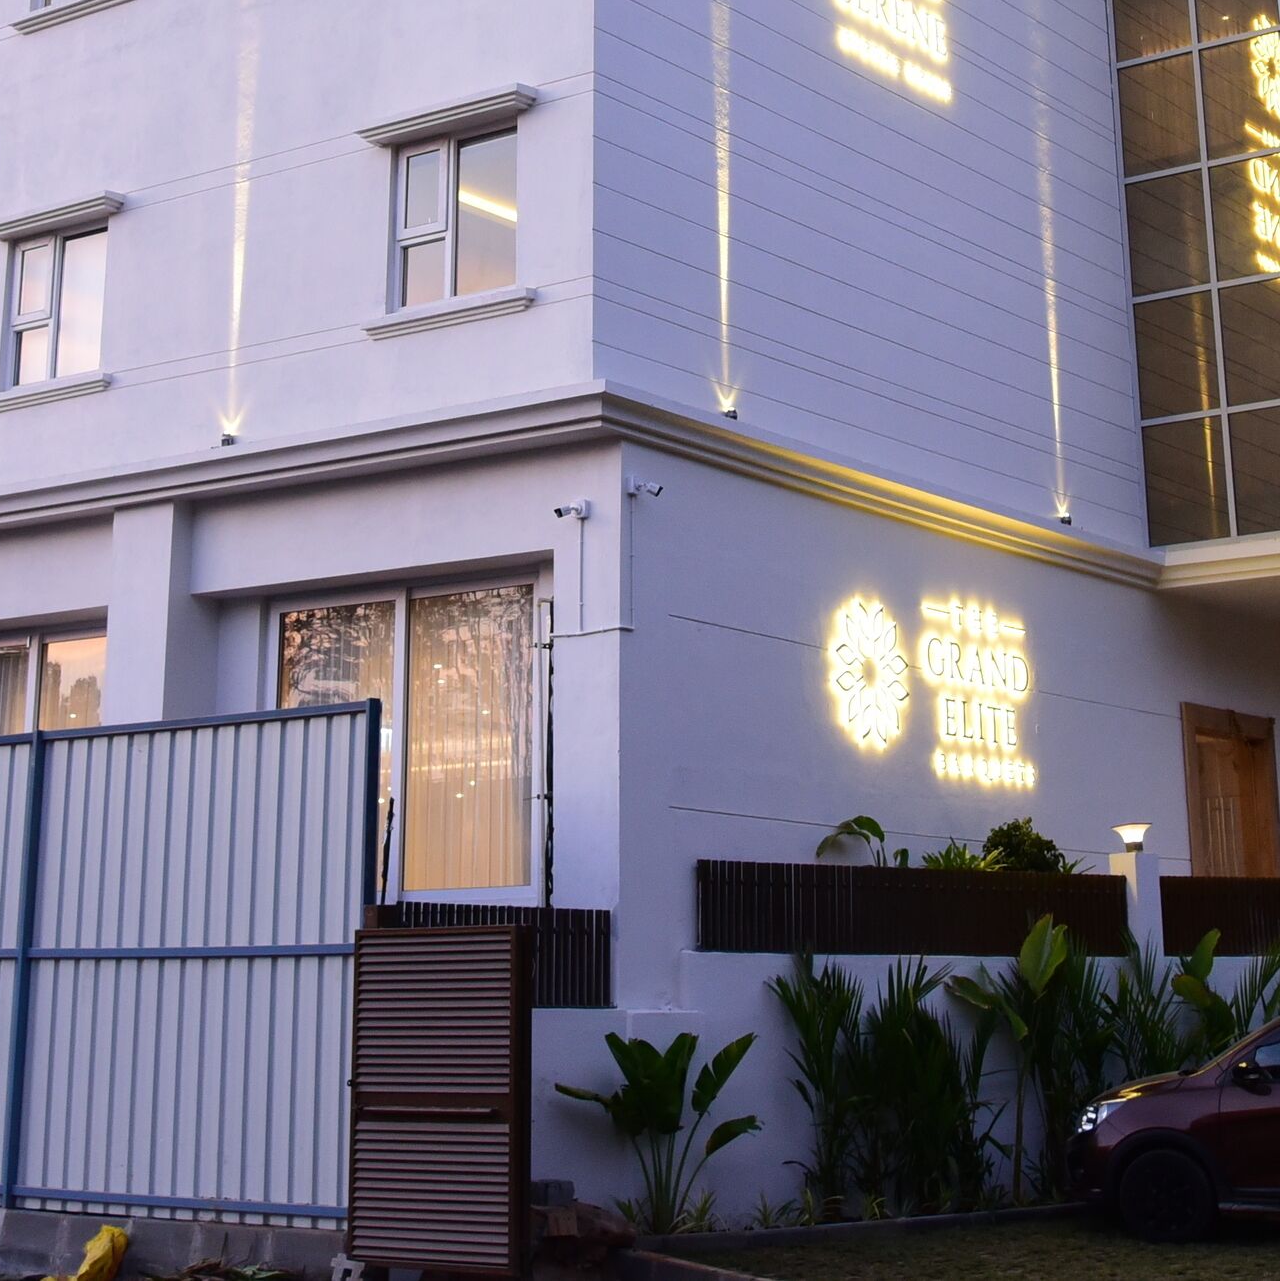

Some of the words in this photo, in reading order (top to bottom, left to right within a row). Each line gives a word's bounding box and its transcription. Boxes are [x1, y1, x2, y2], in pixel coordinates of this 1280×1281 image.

[950, 602, 999, 636] THE
[925, 635, 1030, 693] GRAND
[944, 697, 1017, 746] ELITE
